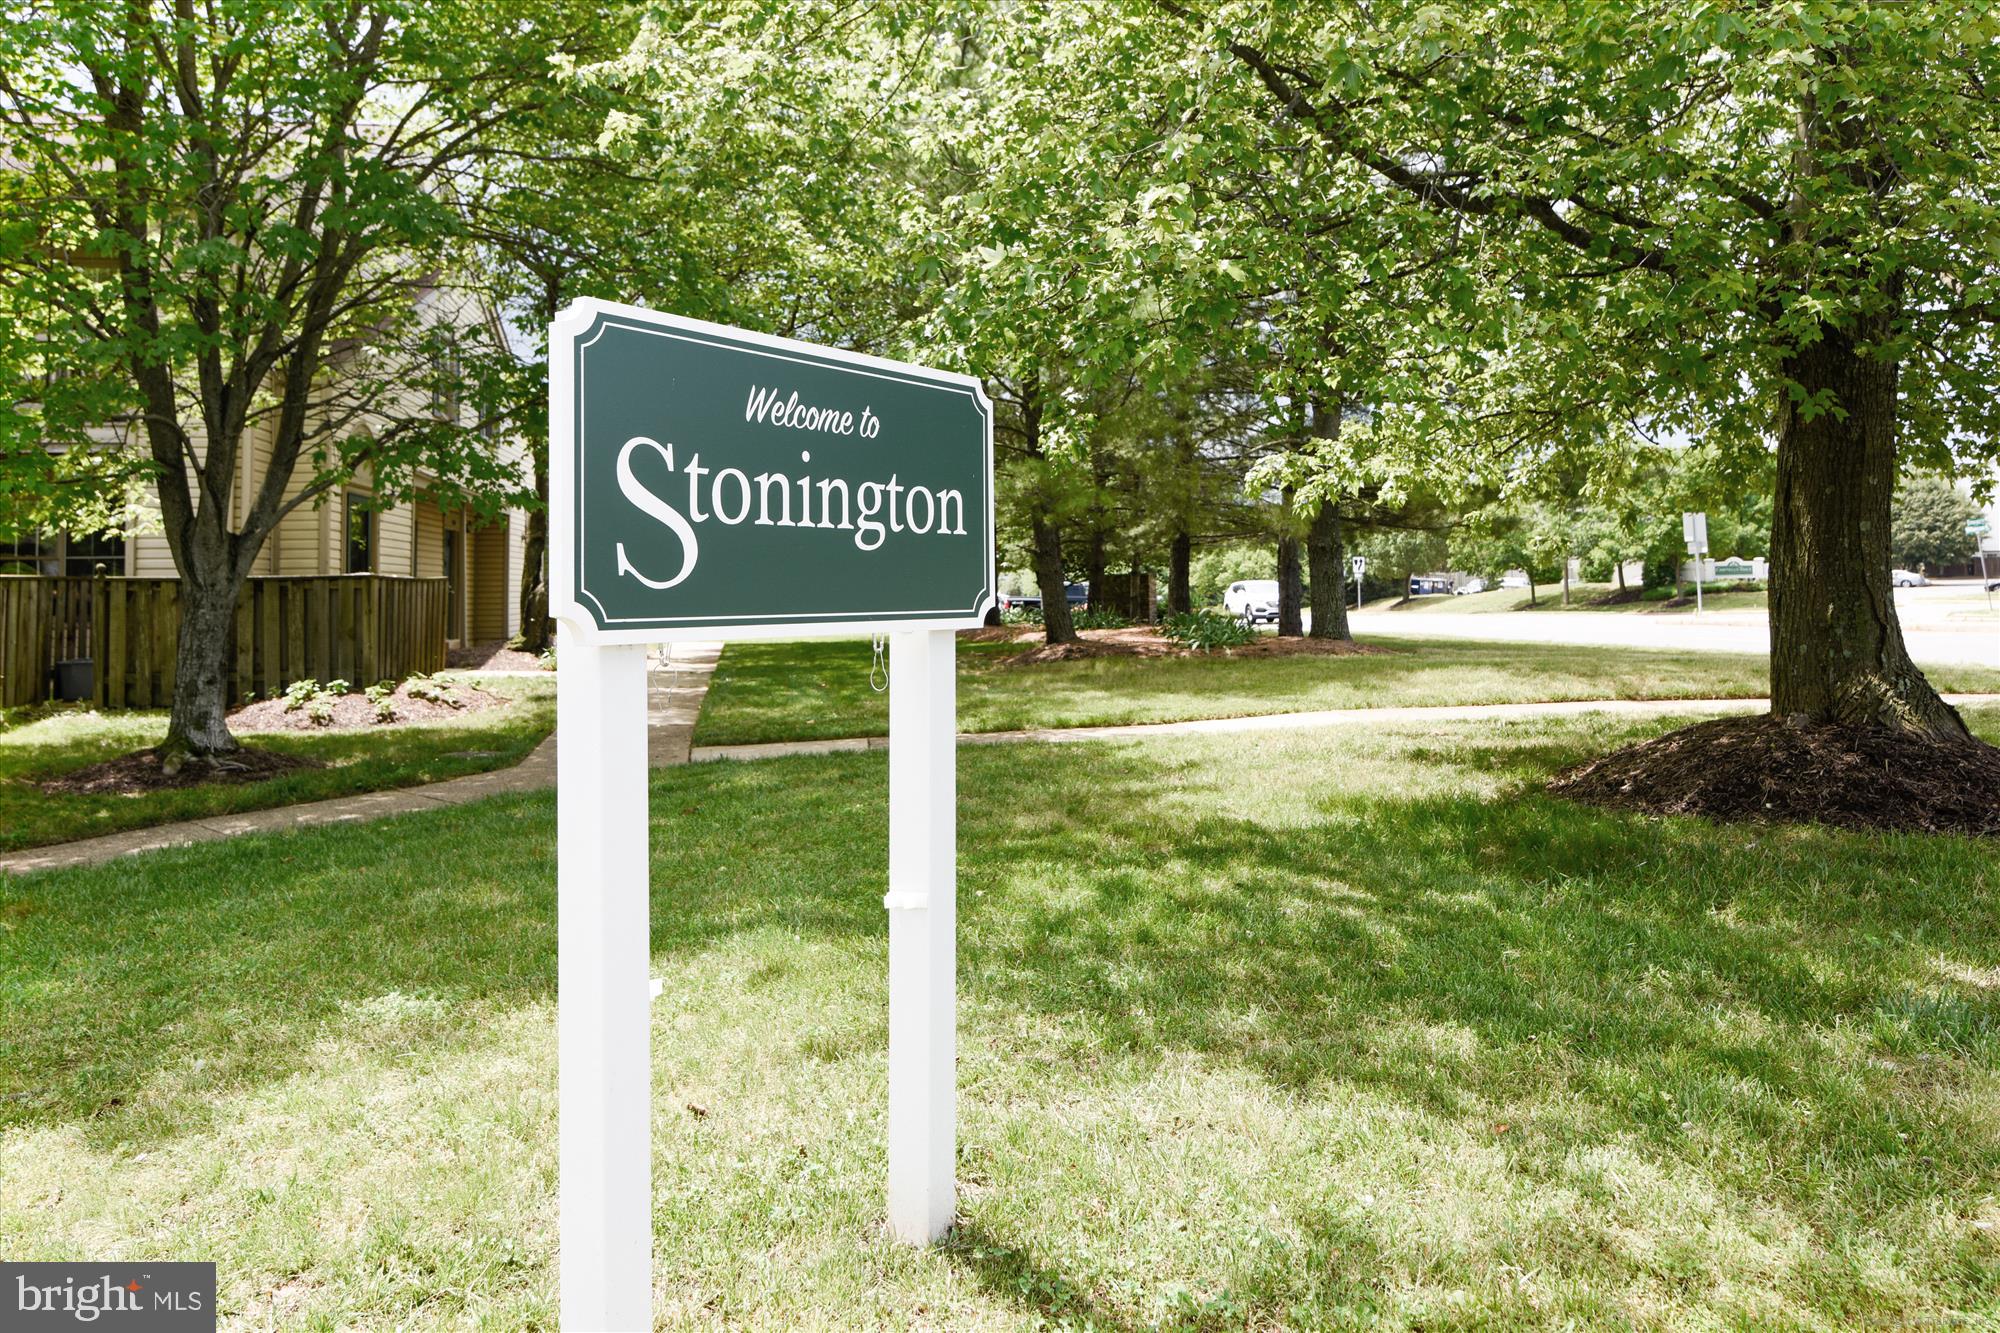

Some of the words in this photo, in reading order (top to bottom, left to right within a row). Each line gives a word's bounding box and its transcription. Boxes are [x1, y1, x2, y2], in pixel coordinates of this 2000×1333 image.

[745, 384, 854, 436] Welcome
[859, 405, 880, 439] to
[616, 436, 968, 590] Stonington
